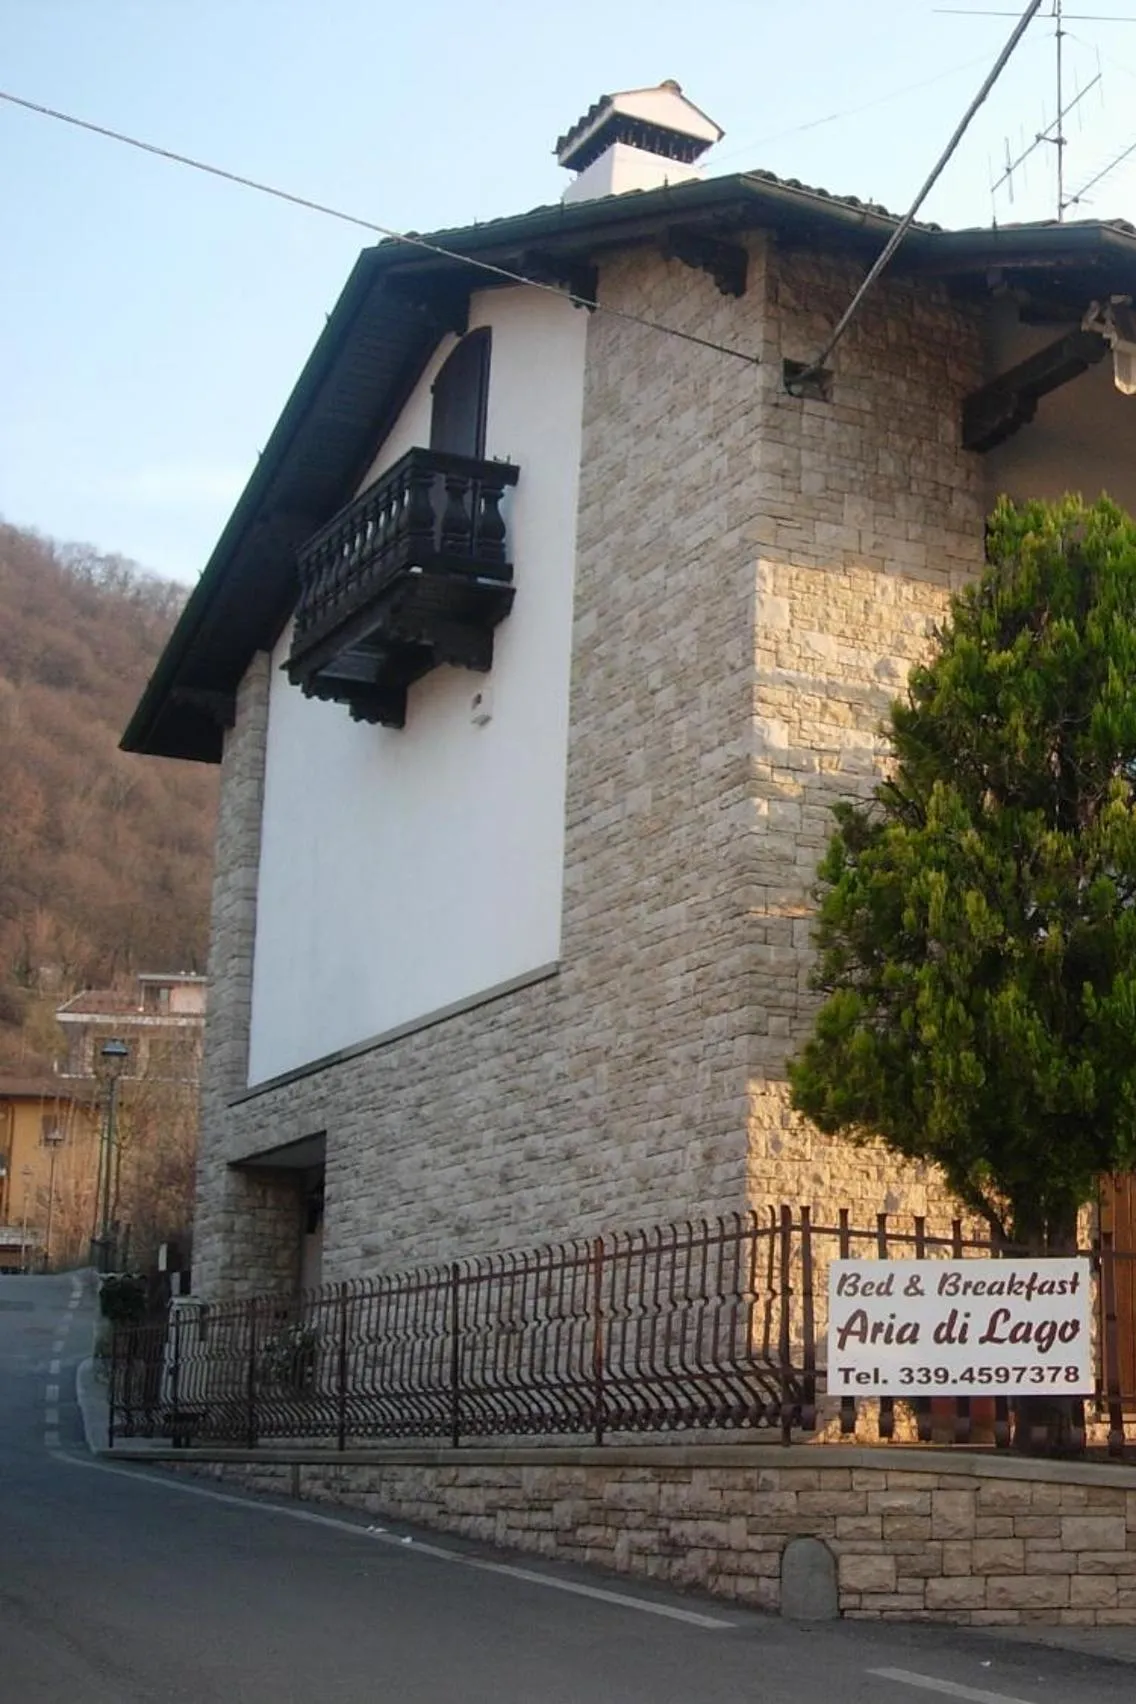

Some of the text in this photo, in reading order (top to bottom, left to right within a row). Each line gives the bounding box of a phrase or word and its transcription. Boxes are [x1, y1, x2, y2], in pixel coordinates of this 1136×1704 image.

[836, 1271, 1080, 1301] Bed & Breakfast
[836, 1307, 1081, 1353] Aria di Lago
[838, 1366, 1080, 1385] Tel. 339.4597378
